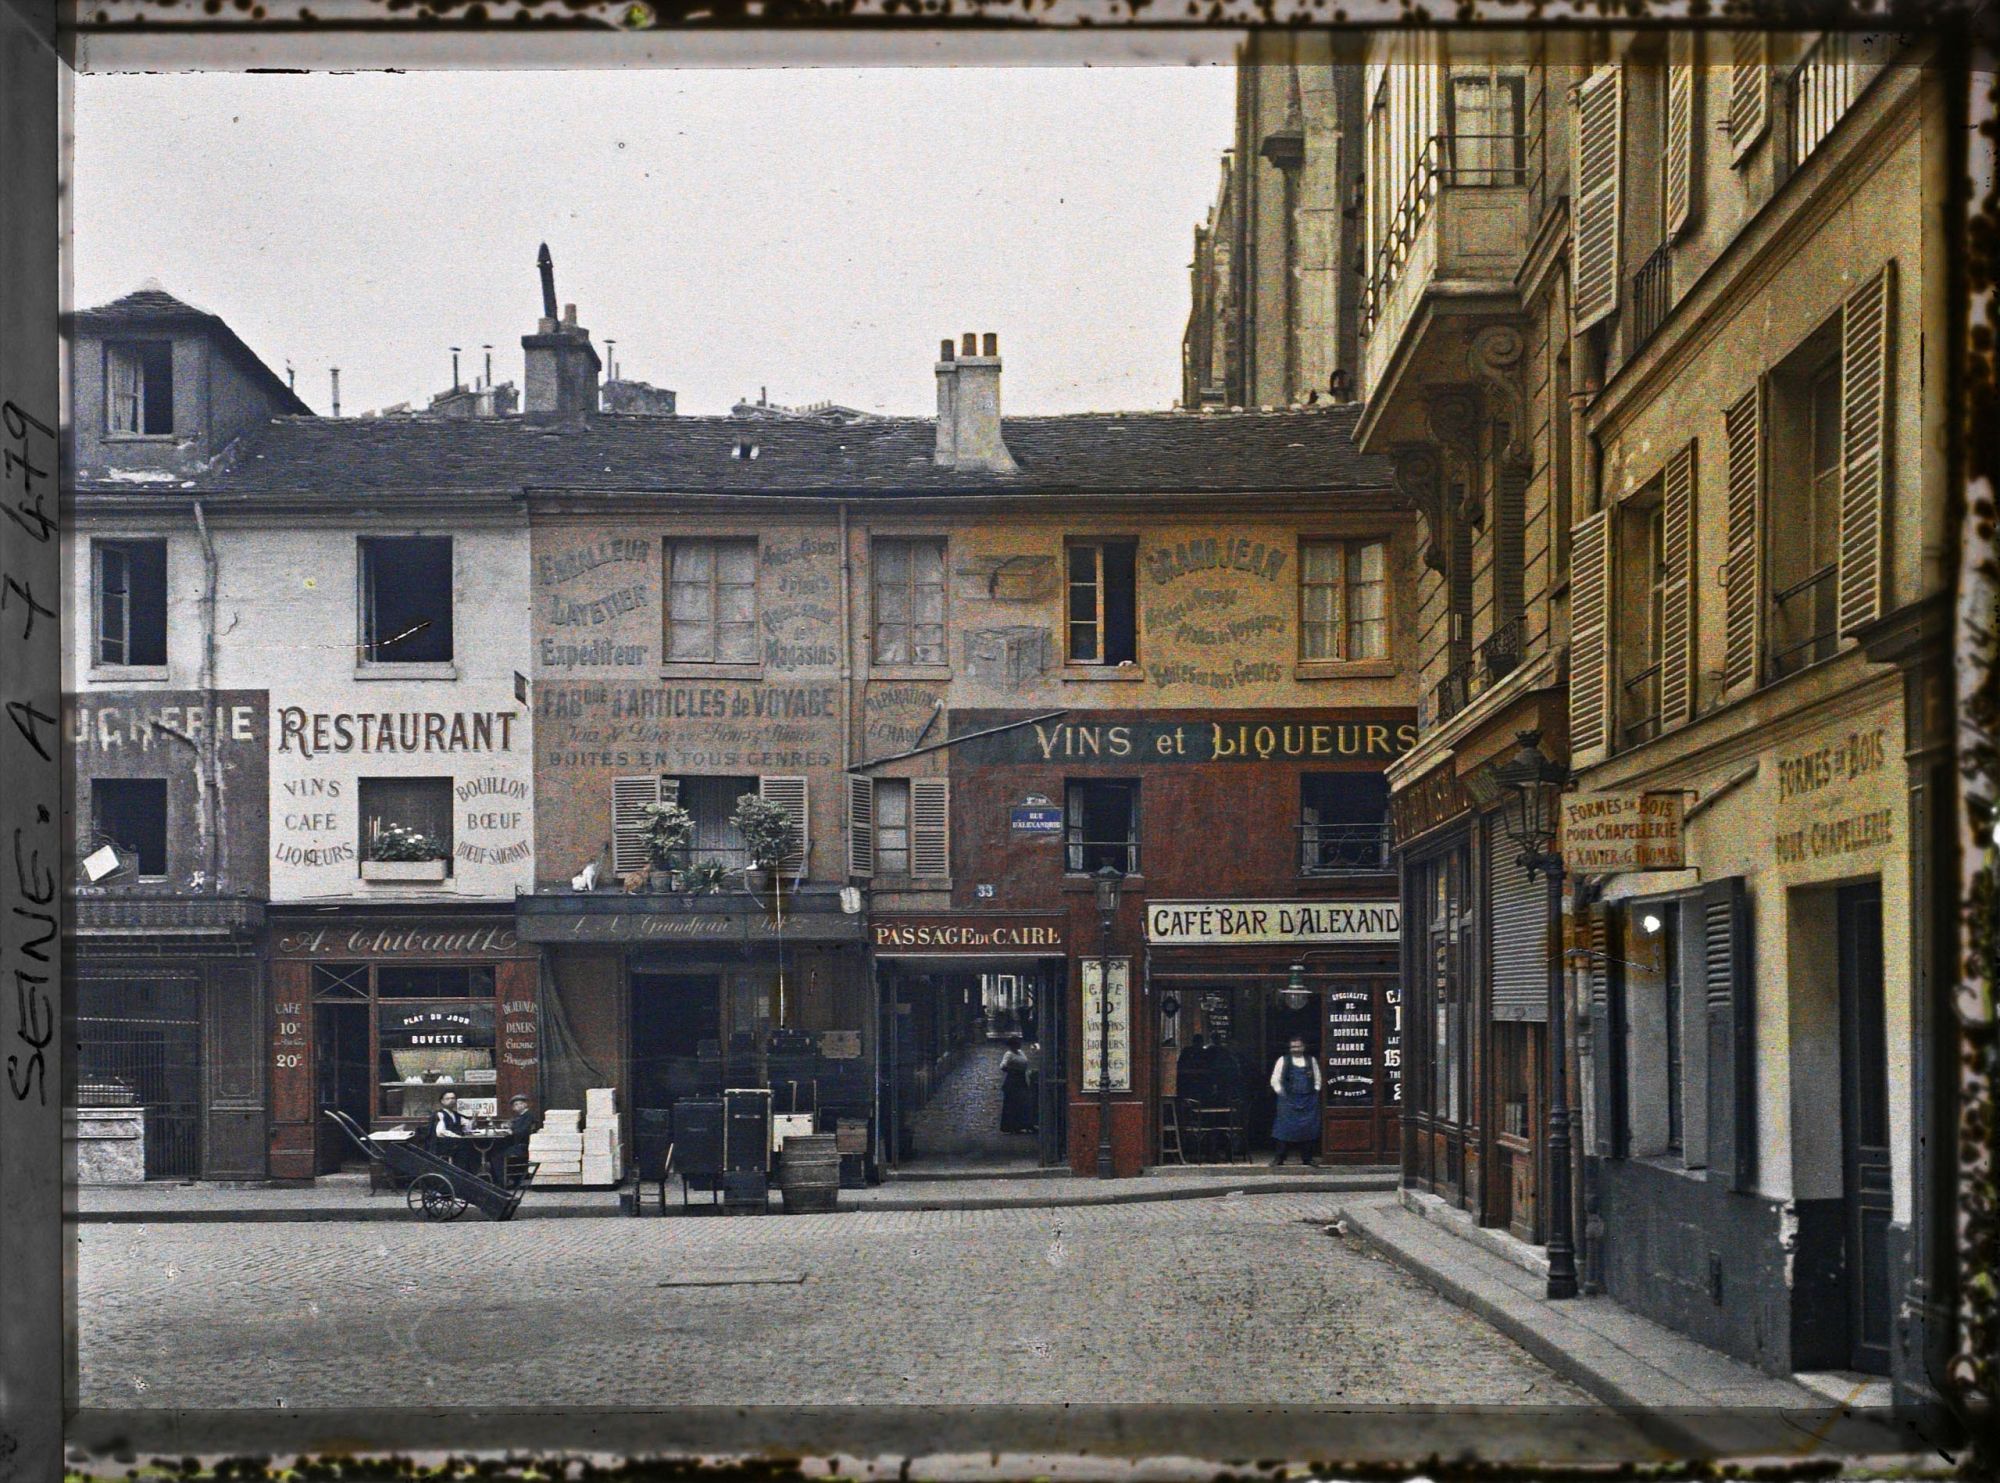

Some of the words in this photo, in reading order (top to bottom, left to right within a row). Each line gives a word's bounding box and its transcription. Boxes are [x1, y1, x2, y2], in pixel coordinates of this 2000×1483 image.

[751, 687, 834, 718] VOYAGE
[6, 700, 57, 762] A
[278, 706, 517, 760] RESTAURANT
[1034, 722, 1133, 759] VINS
[1157, 727, 1186, 755] et
[1211, 722, 1419, 760] LIQUEURS
[550, 751, 629, 767] BOITES
[640, 751, 668, 767] EN
[678, 751, 739, 767] TOUS
[748, 751, 831, 767] GENRES
[283, 777, 342, 798] VINS
[455, 776, 530, 803] BOUILLON
[1567, 798, 1622, 824] FORMES
[1638, 795, 1674, 818] BOIS
[285, 813, 338, 832] CAFE
[467, 812, 523, 831] BŒUF
[1595, 822, 1678, 841] CHAPELLERIE
[977, 884, 994, 898] 33
[1153, 906, 1213, 937] CAFÉ
[1215, 907, 1268, 935] BAR
[1279, 907, 1400, 937] D'ALEXAND
[280, 925, 330, 952] A.
[348, 925, 517, 952] Thibault
[876, 927, 975, 945] PASSAGE
[992, 927, 1062, 945] CAIRE
[1088, 983, 1124, 996] CFE
[275, 1002, 302, 1015] CAFE
[403, 1014, 425, 1026] PLAT
[430, 1013, 442, 1021] DU
[446, 1014, 470, 1025] JOUR
[1329, 1013, 1372, 1023] BEAUJOLAIS
[505, 1022, 537, 1034] DINERS
[1333, 1028, 1369, 1037] BORDEAUX
[411, 1035, 464, 1044] BUVETTE
[1336, 1043, 1365, 1052] SAUMUR
[1328, 1057, 1373, 1066] CHAMPAGNES
